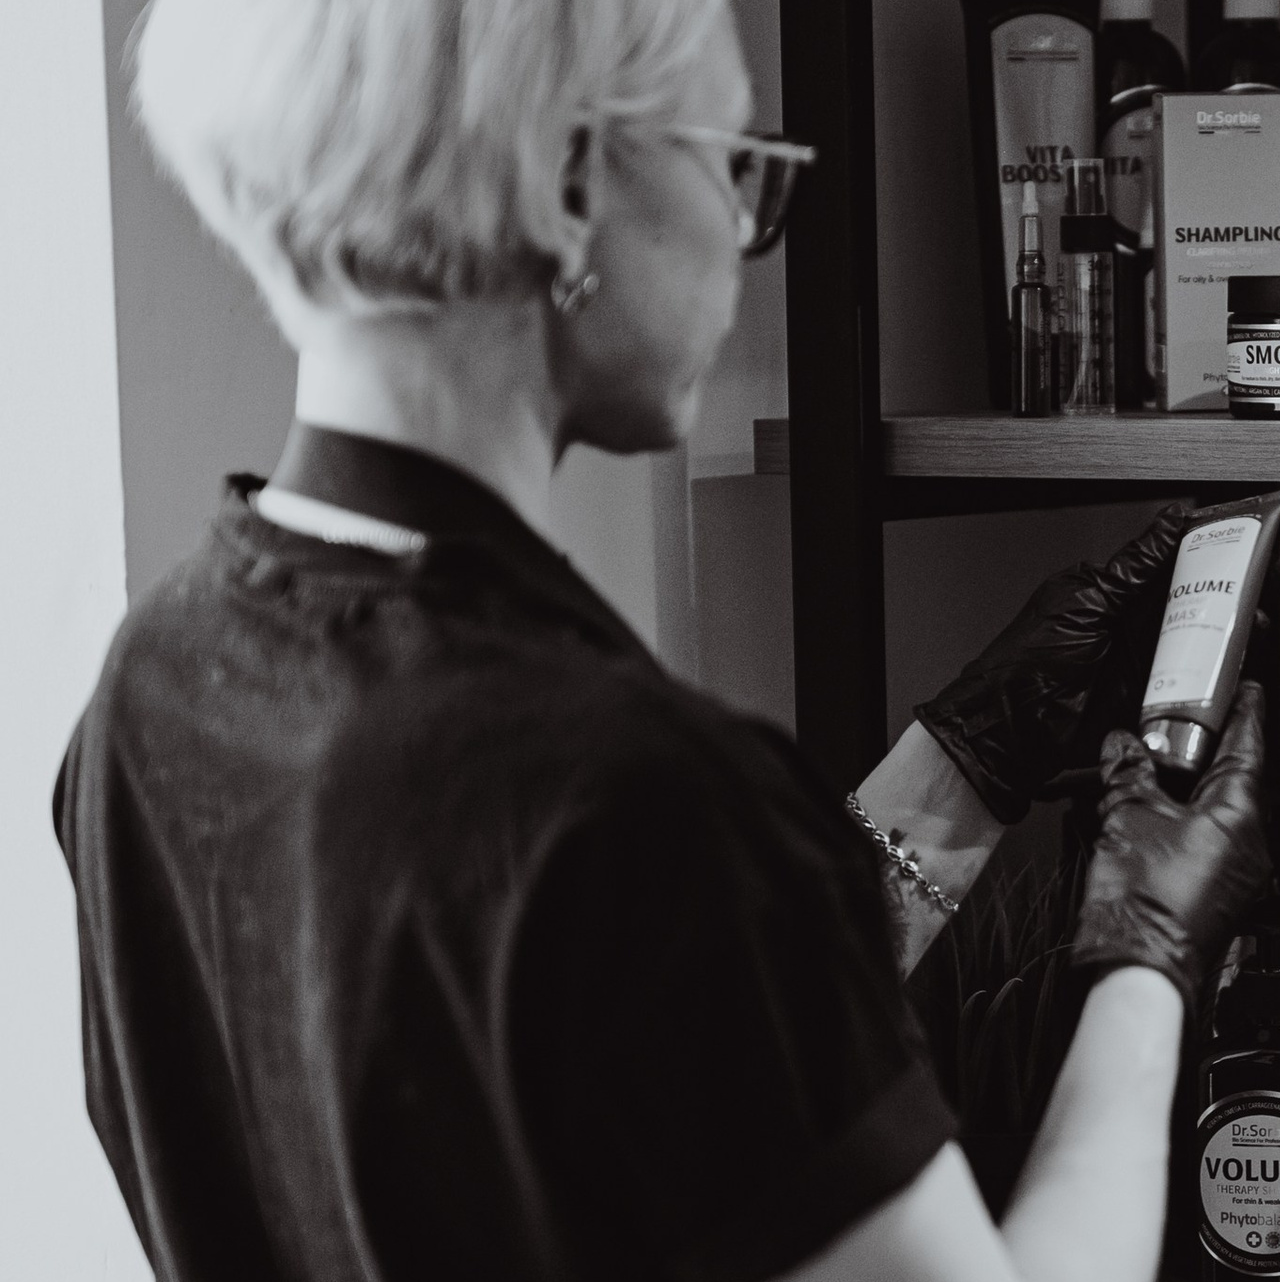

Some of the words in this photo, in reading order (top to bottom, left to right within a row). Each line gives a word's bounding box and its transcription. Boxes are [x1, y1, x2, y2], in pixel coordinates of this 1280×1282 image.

[1196, 110, 1262, 126] Dr.Sorbie
[1001, 163, 1066, 184] BOOS
[1190, 526, 1246, 545] Dr.Sorbie
[1166, 579, 1237, 604] VOLUME
[1216, 1185, 1260, 1195] THERAPY
[1232, 1197, 1243, 1205] For
